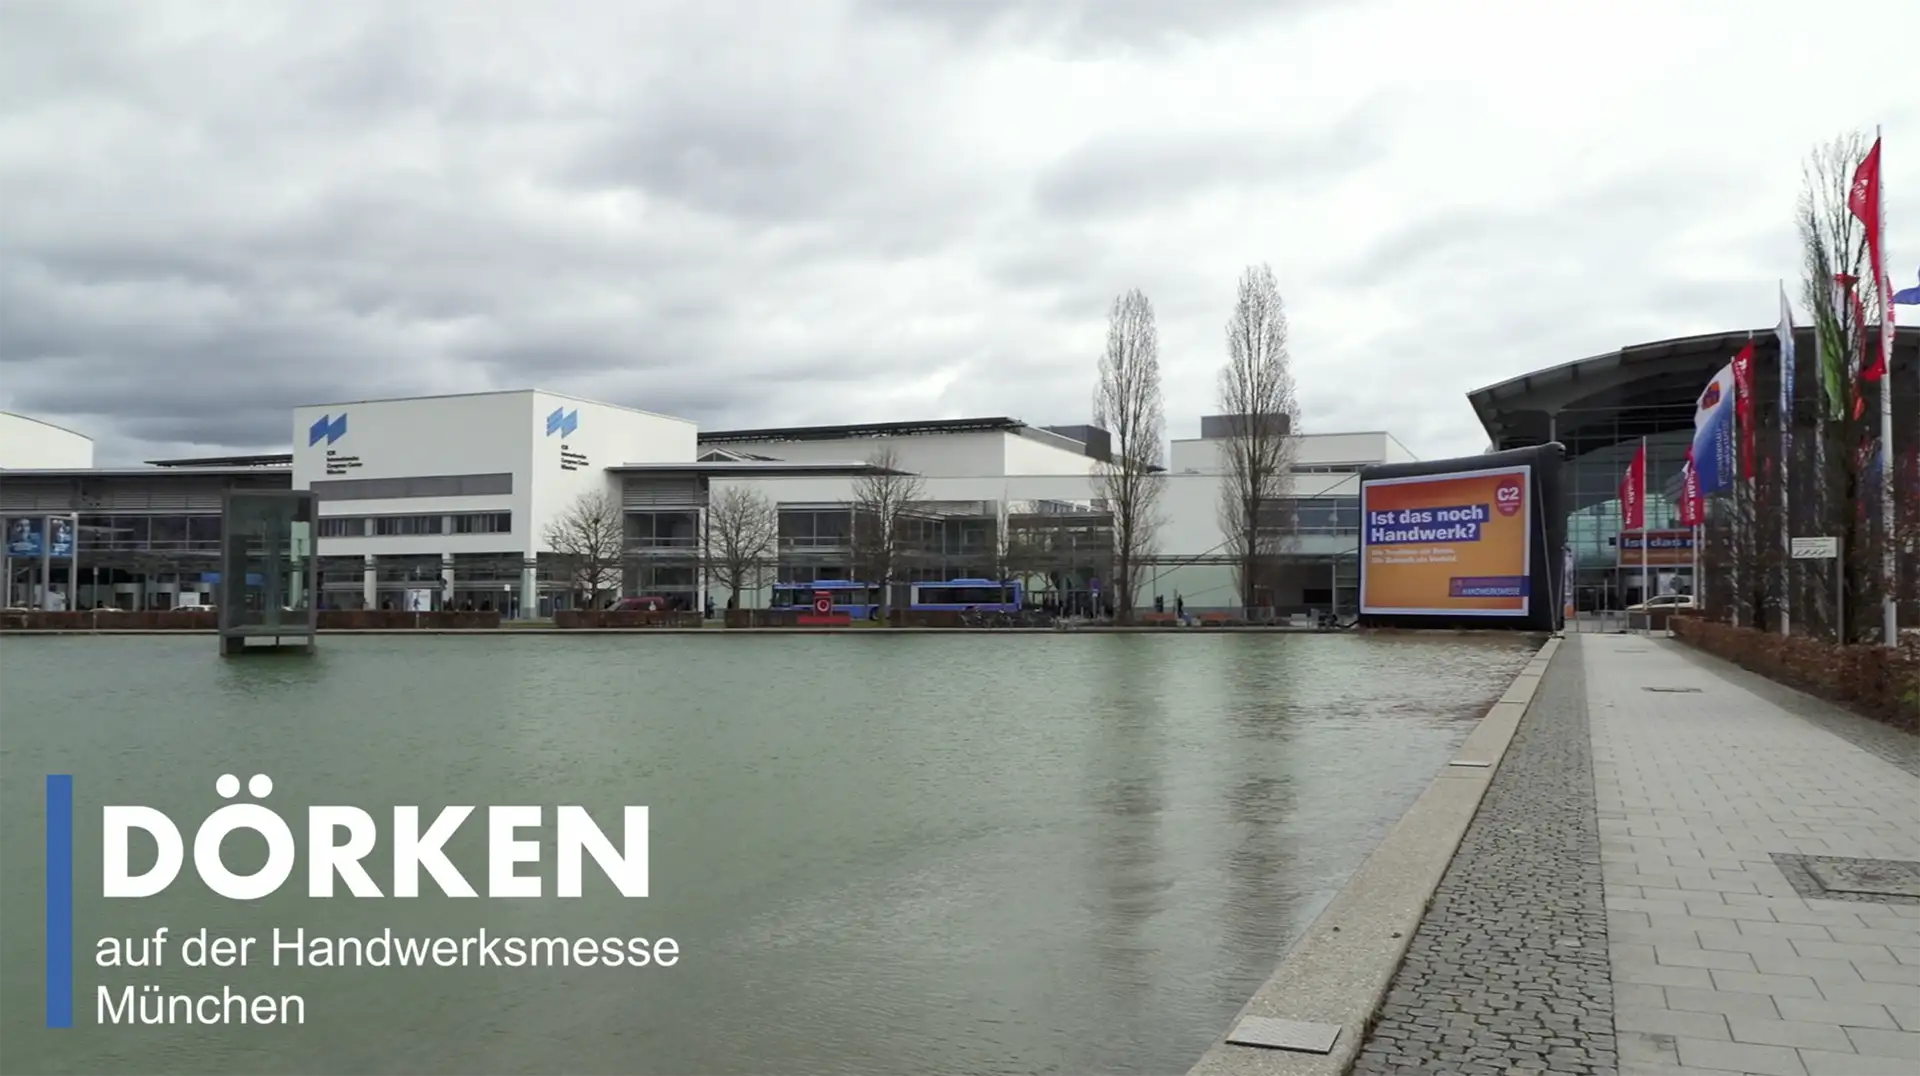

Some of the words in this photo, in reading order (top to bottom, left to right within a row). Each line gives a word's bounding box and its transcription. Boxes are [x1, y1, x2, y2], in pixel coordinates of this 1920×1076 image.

[1497, 487, 1519, 501] C2
[1371, 511, 1394, 525] Ist
[1399, 509, 1432, 524] das
[1437, 505, 1483, 521] noch
[1371, 523, 1476, 542] Handwerk?
